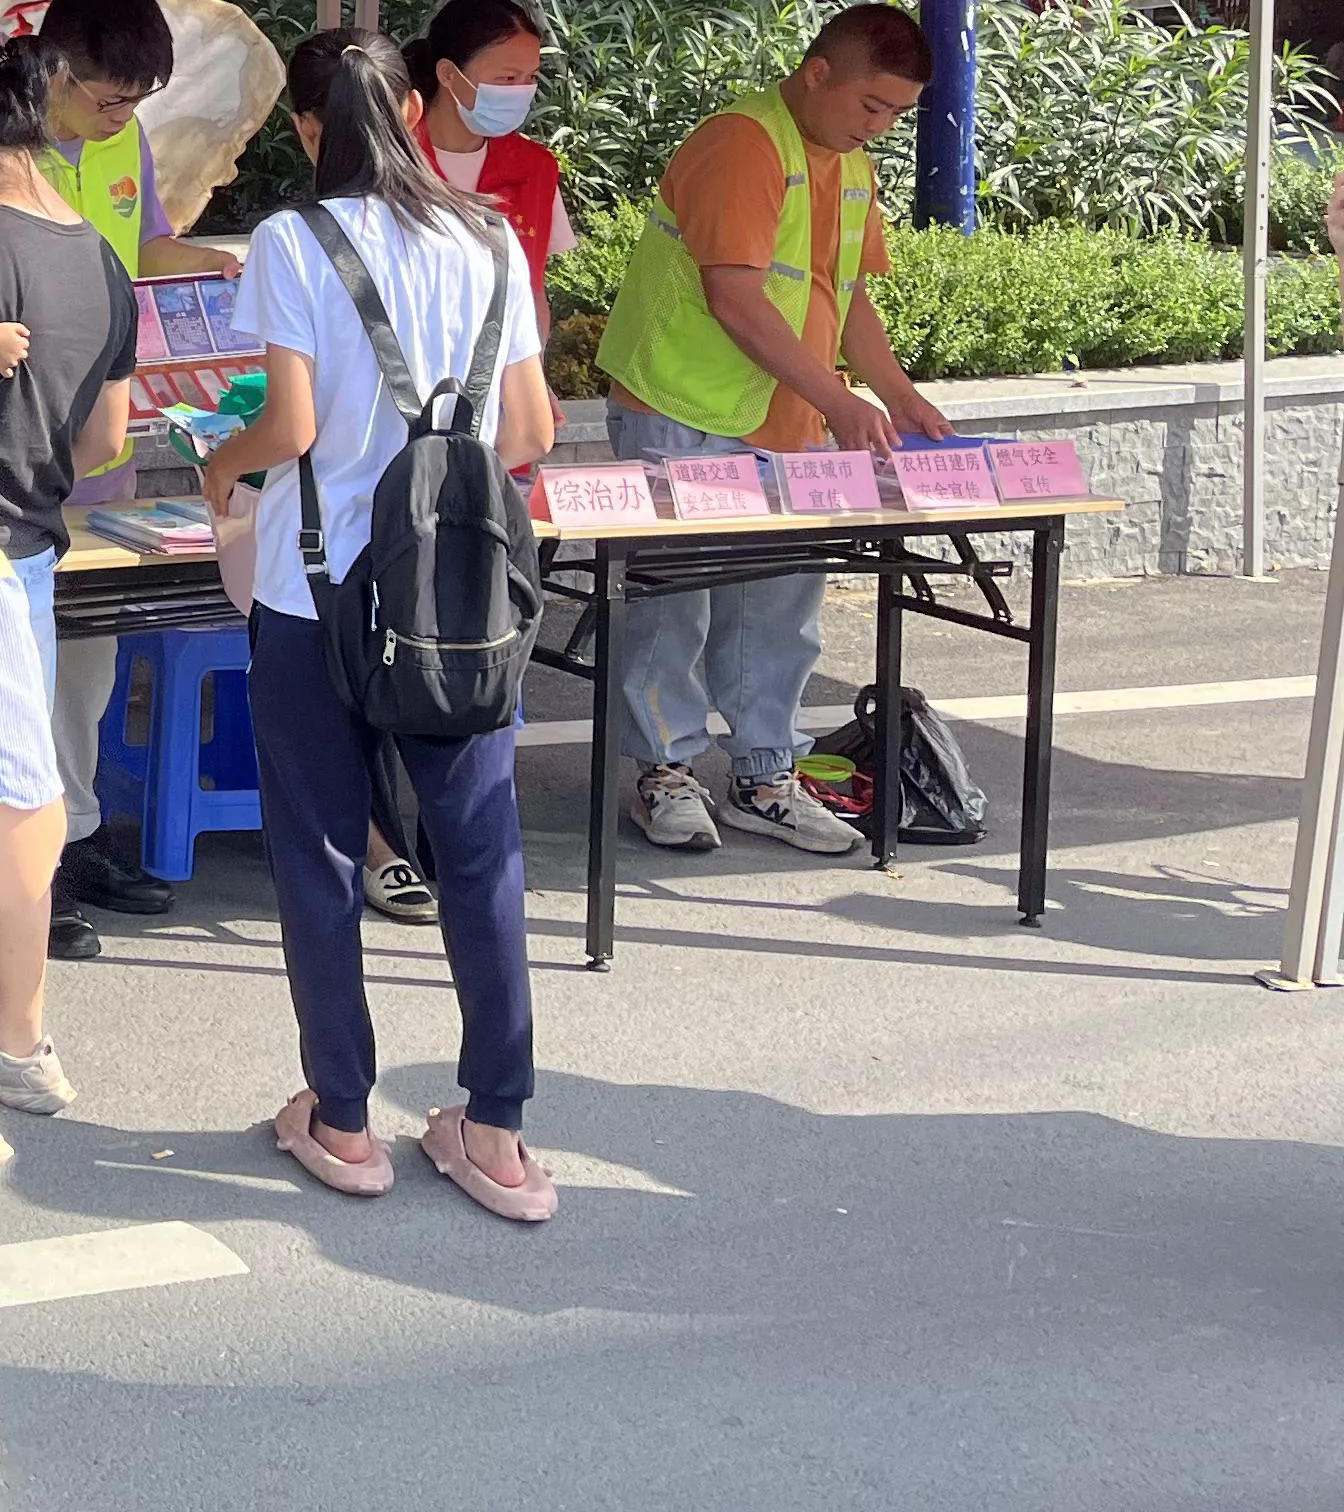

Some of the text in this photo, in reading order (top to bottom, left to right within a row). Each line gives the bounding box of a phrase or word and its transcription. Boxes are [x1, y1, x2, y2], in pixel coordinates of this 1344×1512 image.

[674, 461, 740, 482] 道路交通
[785, 459, 853, 480] 无废城市
[901, 452, 981, 473] 农村自建房
[553, 477, 646, 513] 综治办
[915, 479, 981, 501] 安全宣传
[1020, 474, 1054, 495] 宣传
[682, 488, 748, 513] 安全宣传
[808, 487, 844, 509] 宣传
